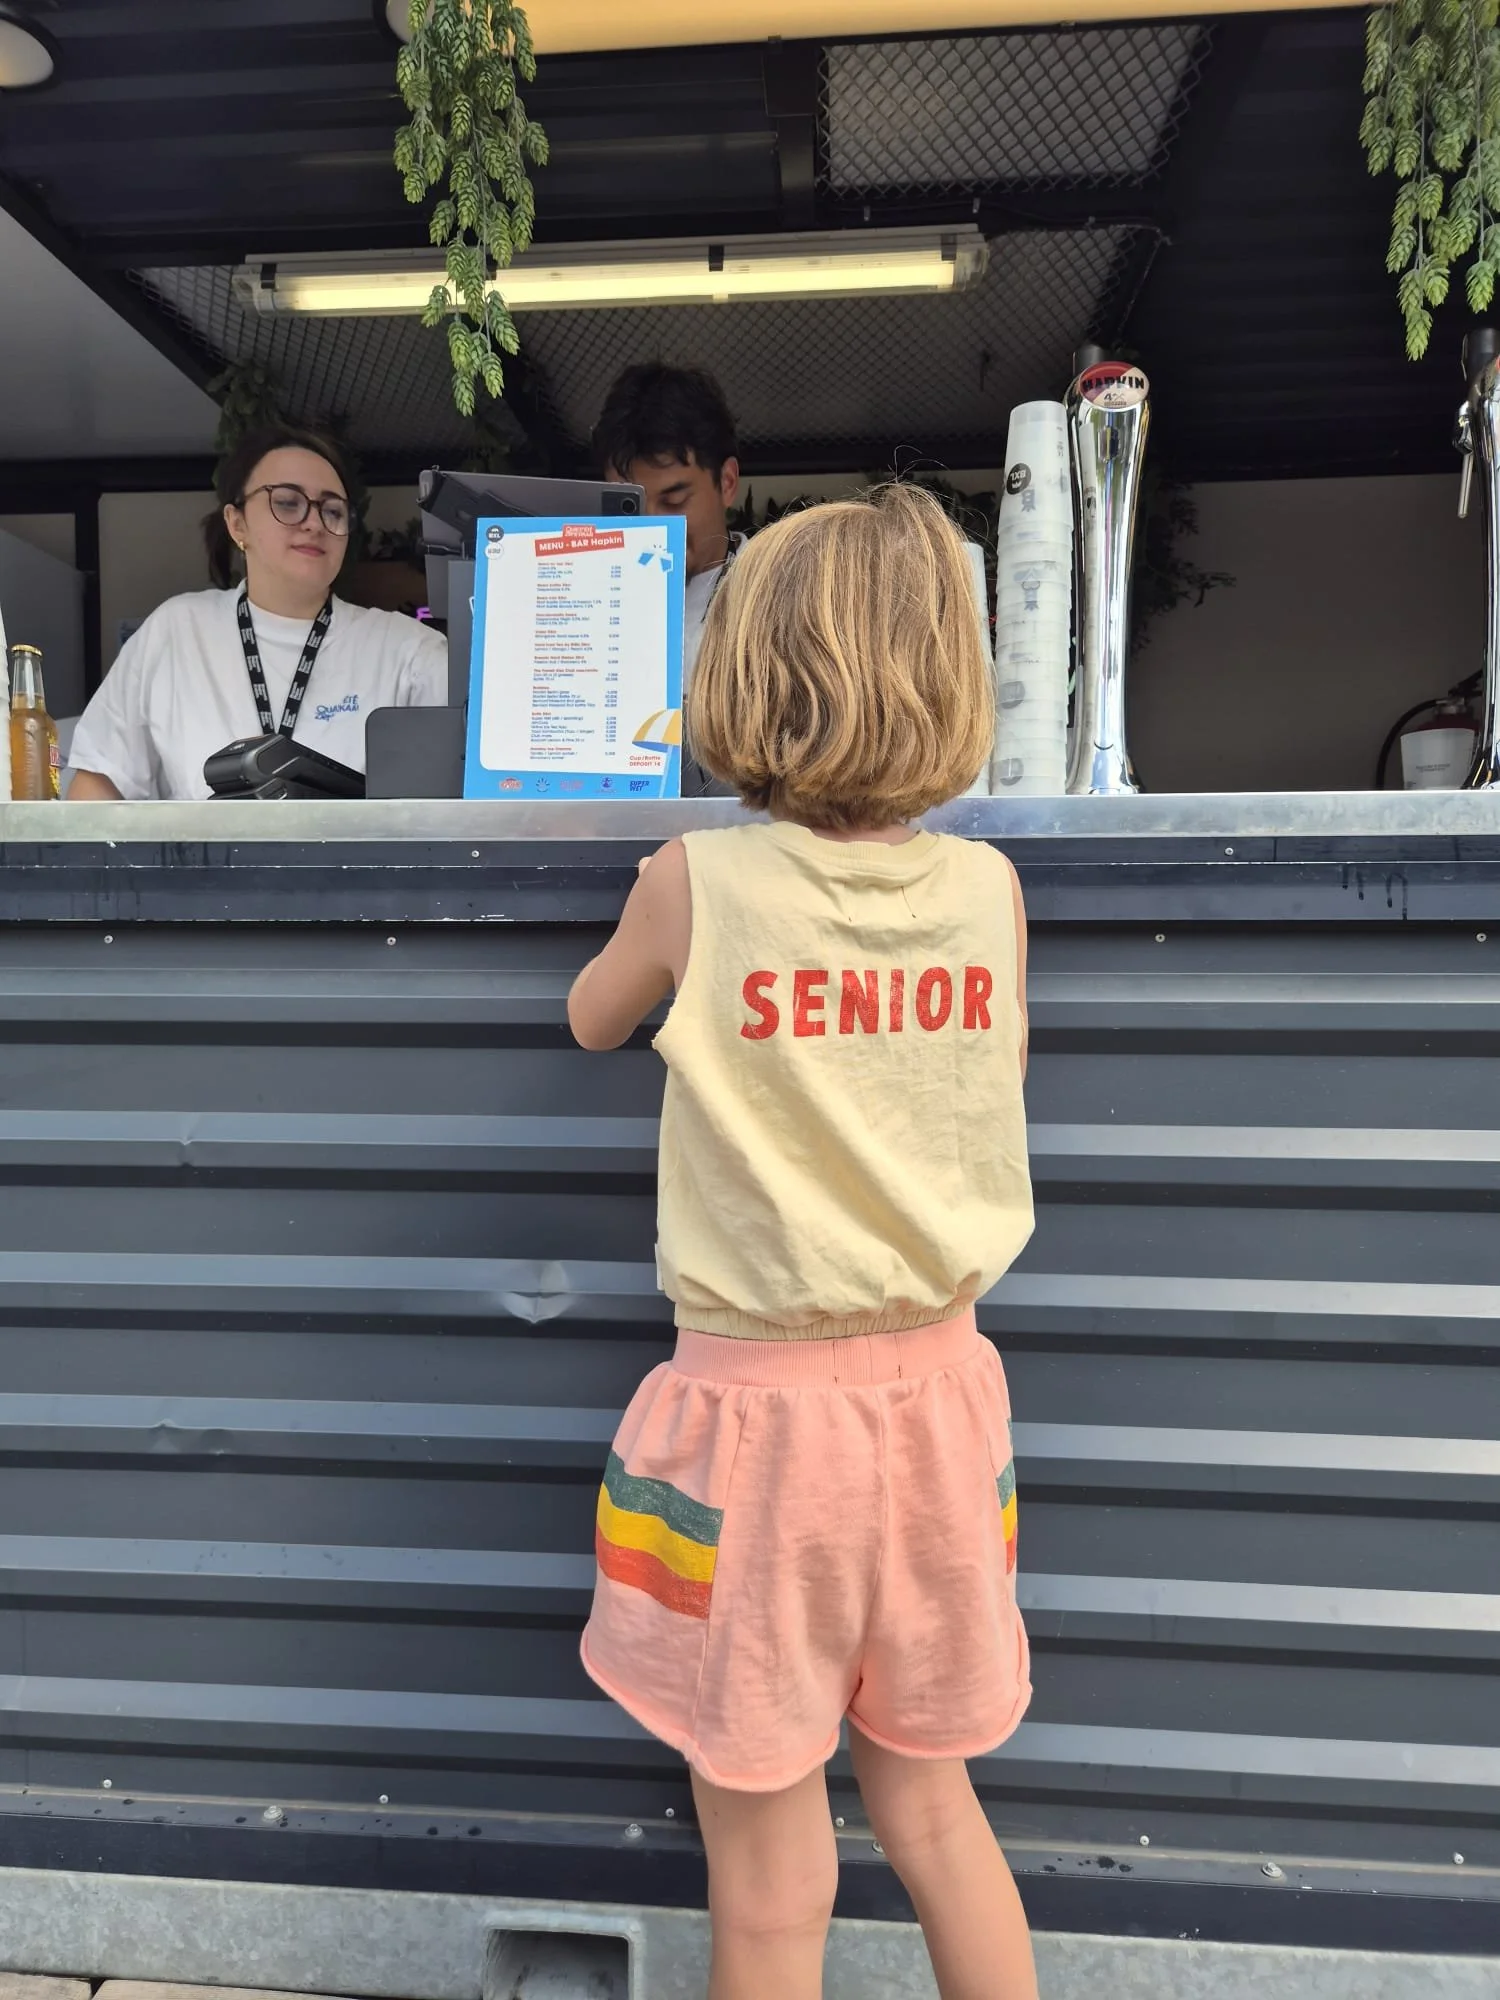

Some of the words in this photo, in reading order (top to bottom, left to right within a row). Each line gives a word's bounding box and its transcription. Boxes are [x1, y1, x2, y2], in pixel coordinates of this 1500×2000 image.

[539, 541, 564, 551] MENU
[571, 539, 589, 548] BAR
[591, 535, 623, 547] Hapkin
[740, 965, 993, 1040] SENIOR
